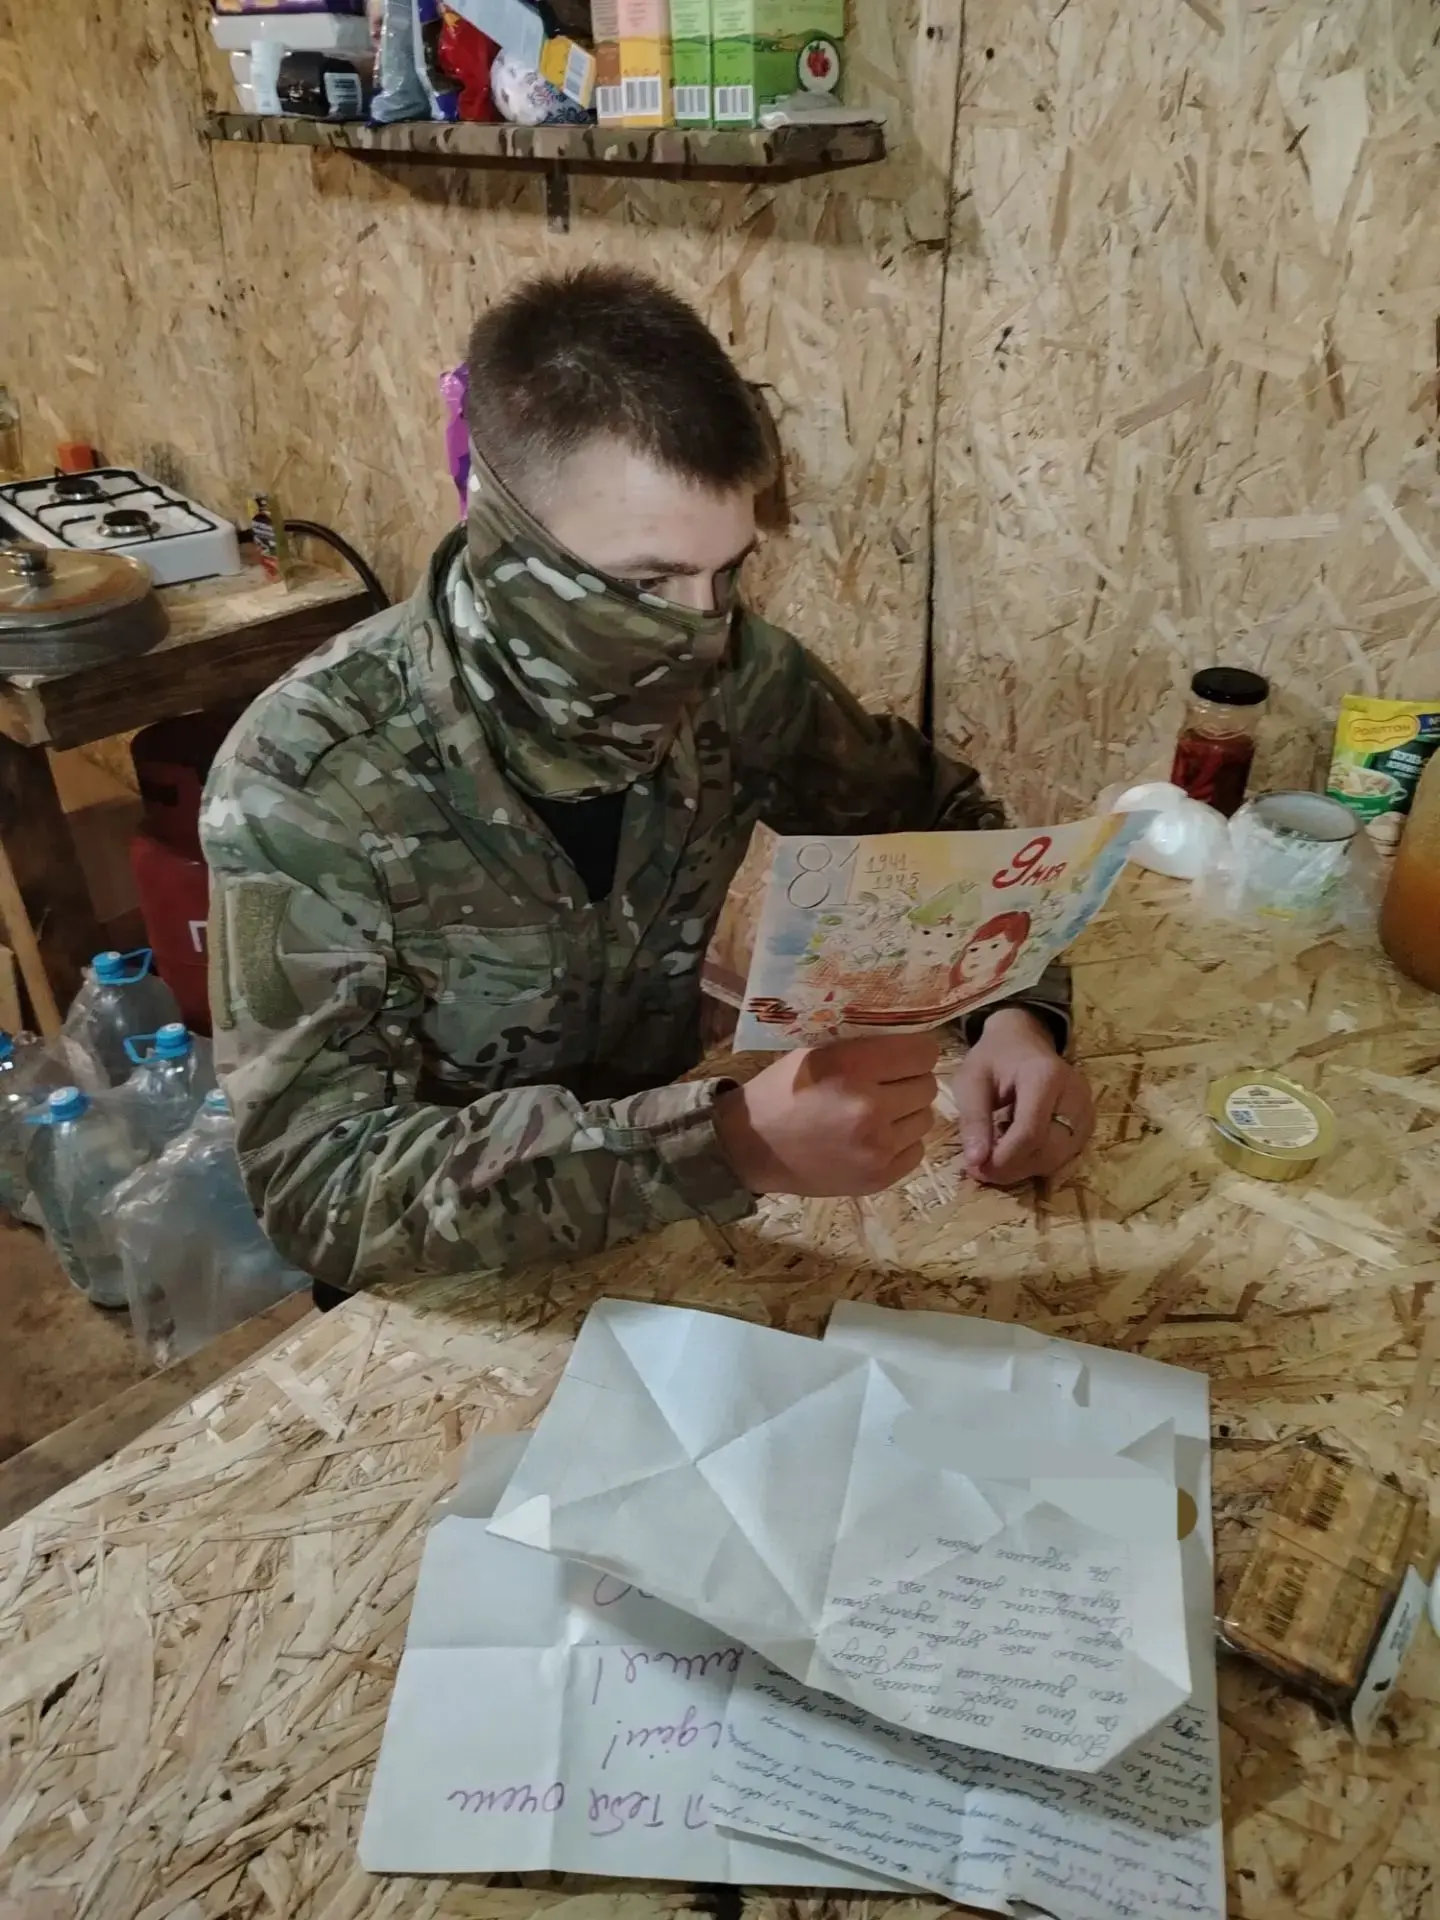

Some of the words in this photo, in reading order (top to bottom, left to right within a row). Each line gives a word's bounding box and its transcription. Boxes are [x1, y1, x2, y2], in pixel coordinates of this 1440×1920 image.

[787, 842, 863, 909] 81
[872, 871, 921, 890] 1945
[992, 836, 1052, 889] 9
[446, 1781, 565, 1815] очень
